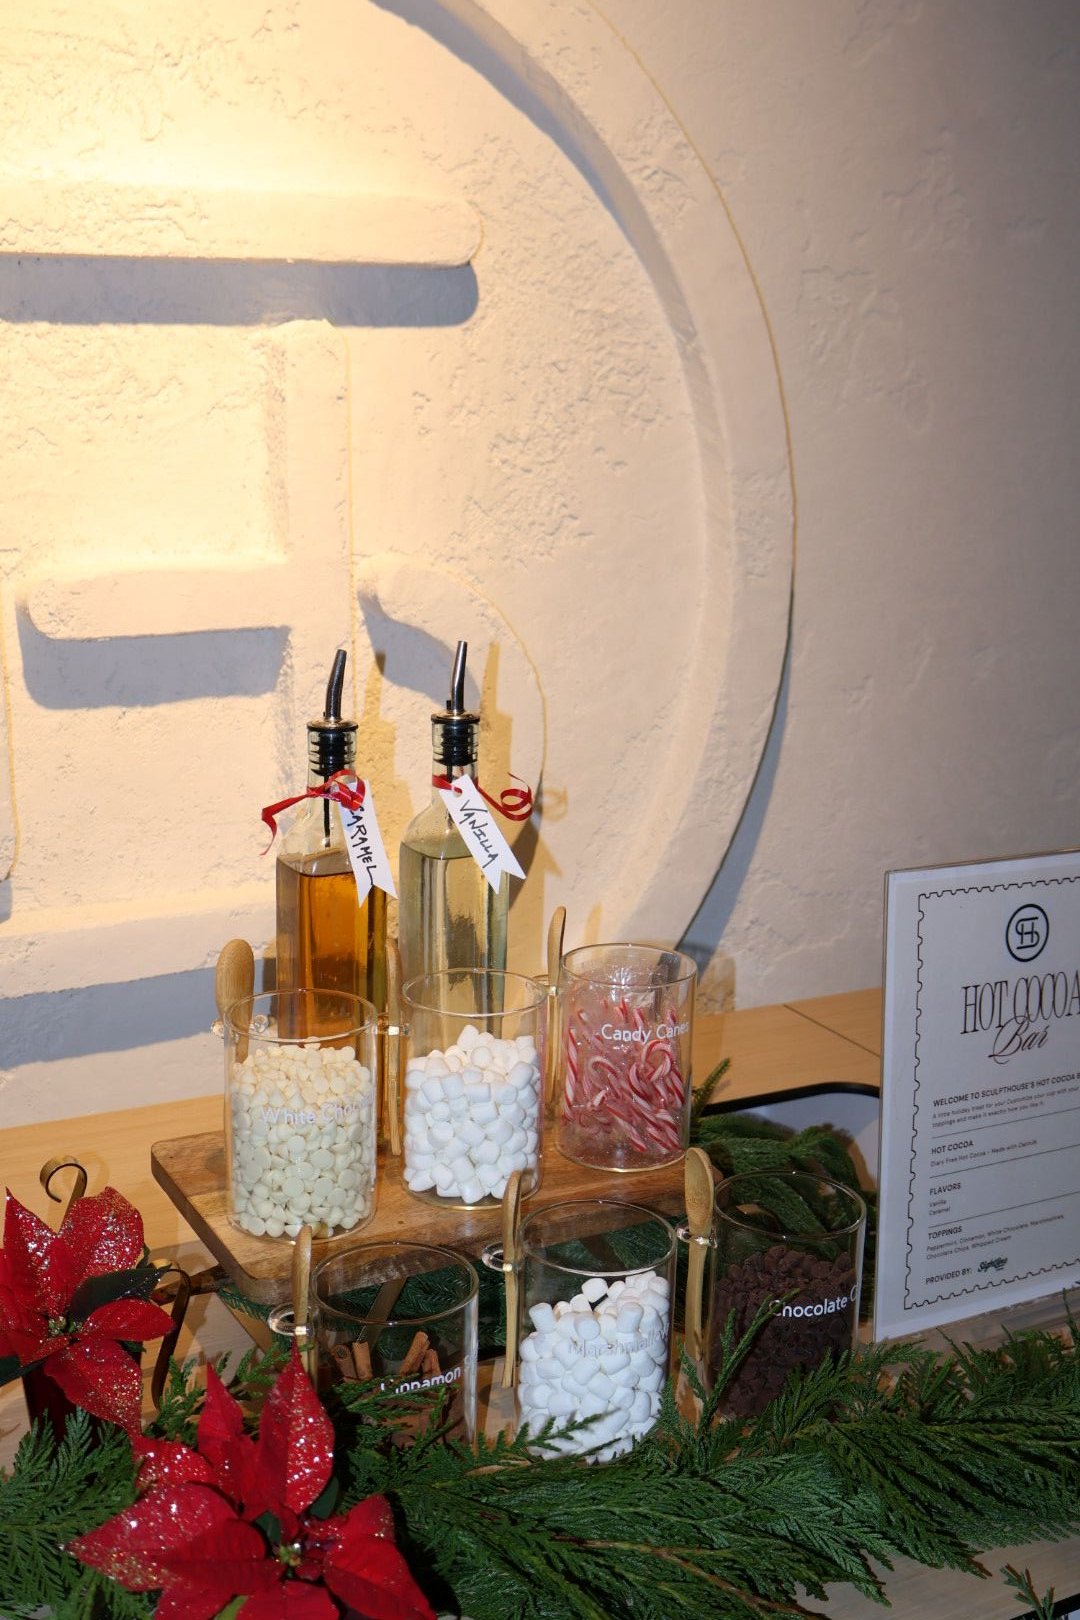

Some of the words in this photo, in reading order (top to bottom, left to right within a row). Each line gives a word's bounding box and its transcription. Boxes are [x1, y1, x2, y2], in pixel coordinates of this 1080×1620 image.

[460, 799, 499, 869] VANILLA
[960, 980, 1009, 1034] HOT
[1013, 970, 1080, 1025] COCOA
[601, 1023, 652, 1045] Candy
[656, 1021, 689, 1039] Canes
[988, 1015, 1050, 1065] Bar
[933, 1094, 969, 1107] WELCOME
[970, 1091, 980, 1100] TO
[981, 1081, 1036, 1099] SCULPTHOUSE'S
[1036, 1077, 1050, 1088] HOT
[1051, 1073, 1076, 1085] COCOA
[262, 1105, 316, 1125] White
[931, 1145, 947, 1155] HOT
[947, 1140, 974, 1151] COCOA
[929, 1182, 962, 1196] FLAVORS
[927, 1225, 963, 1240] TOPPINGS
[925, 1269, 961, 1285] PROVIDED
[961, 1267, 973, 1276] BY:
